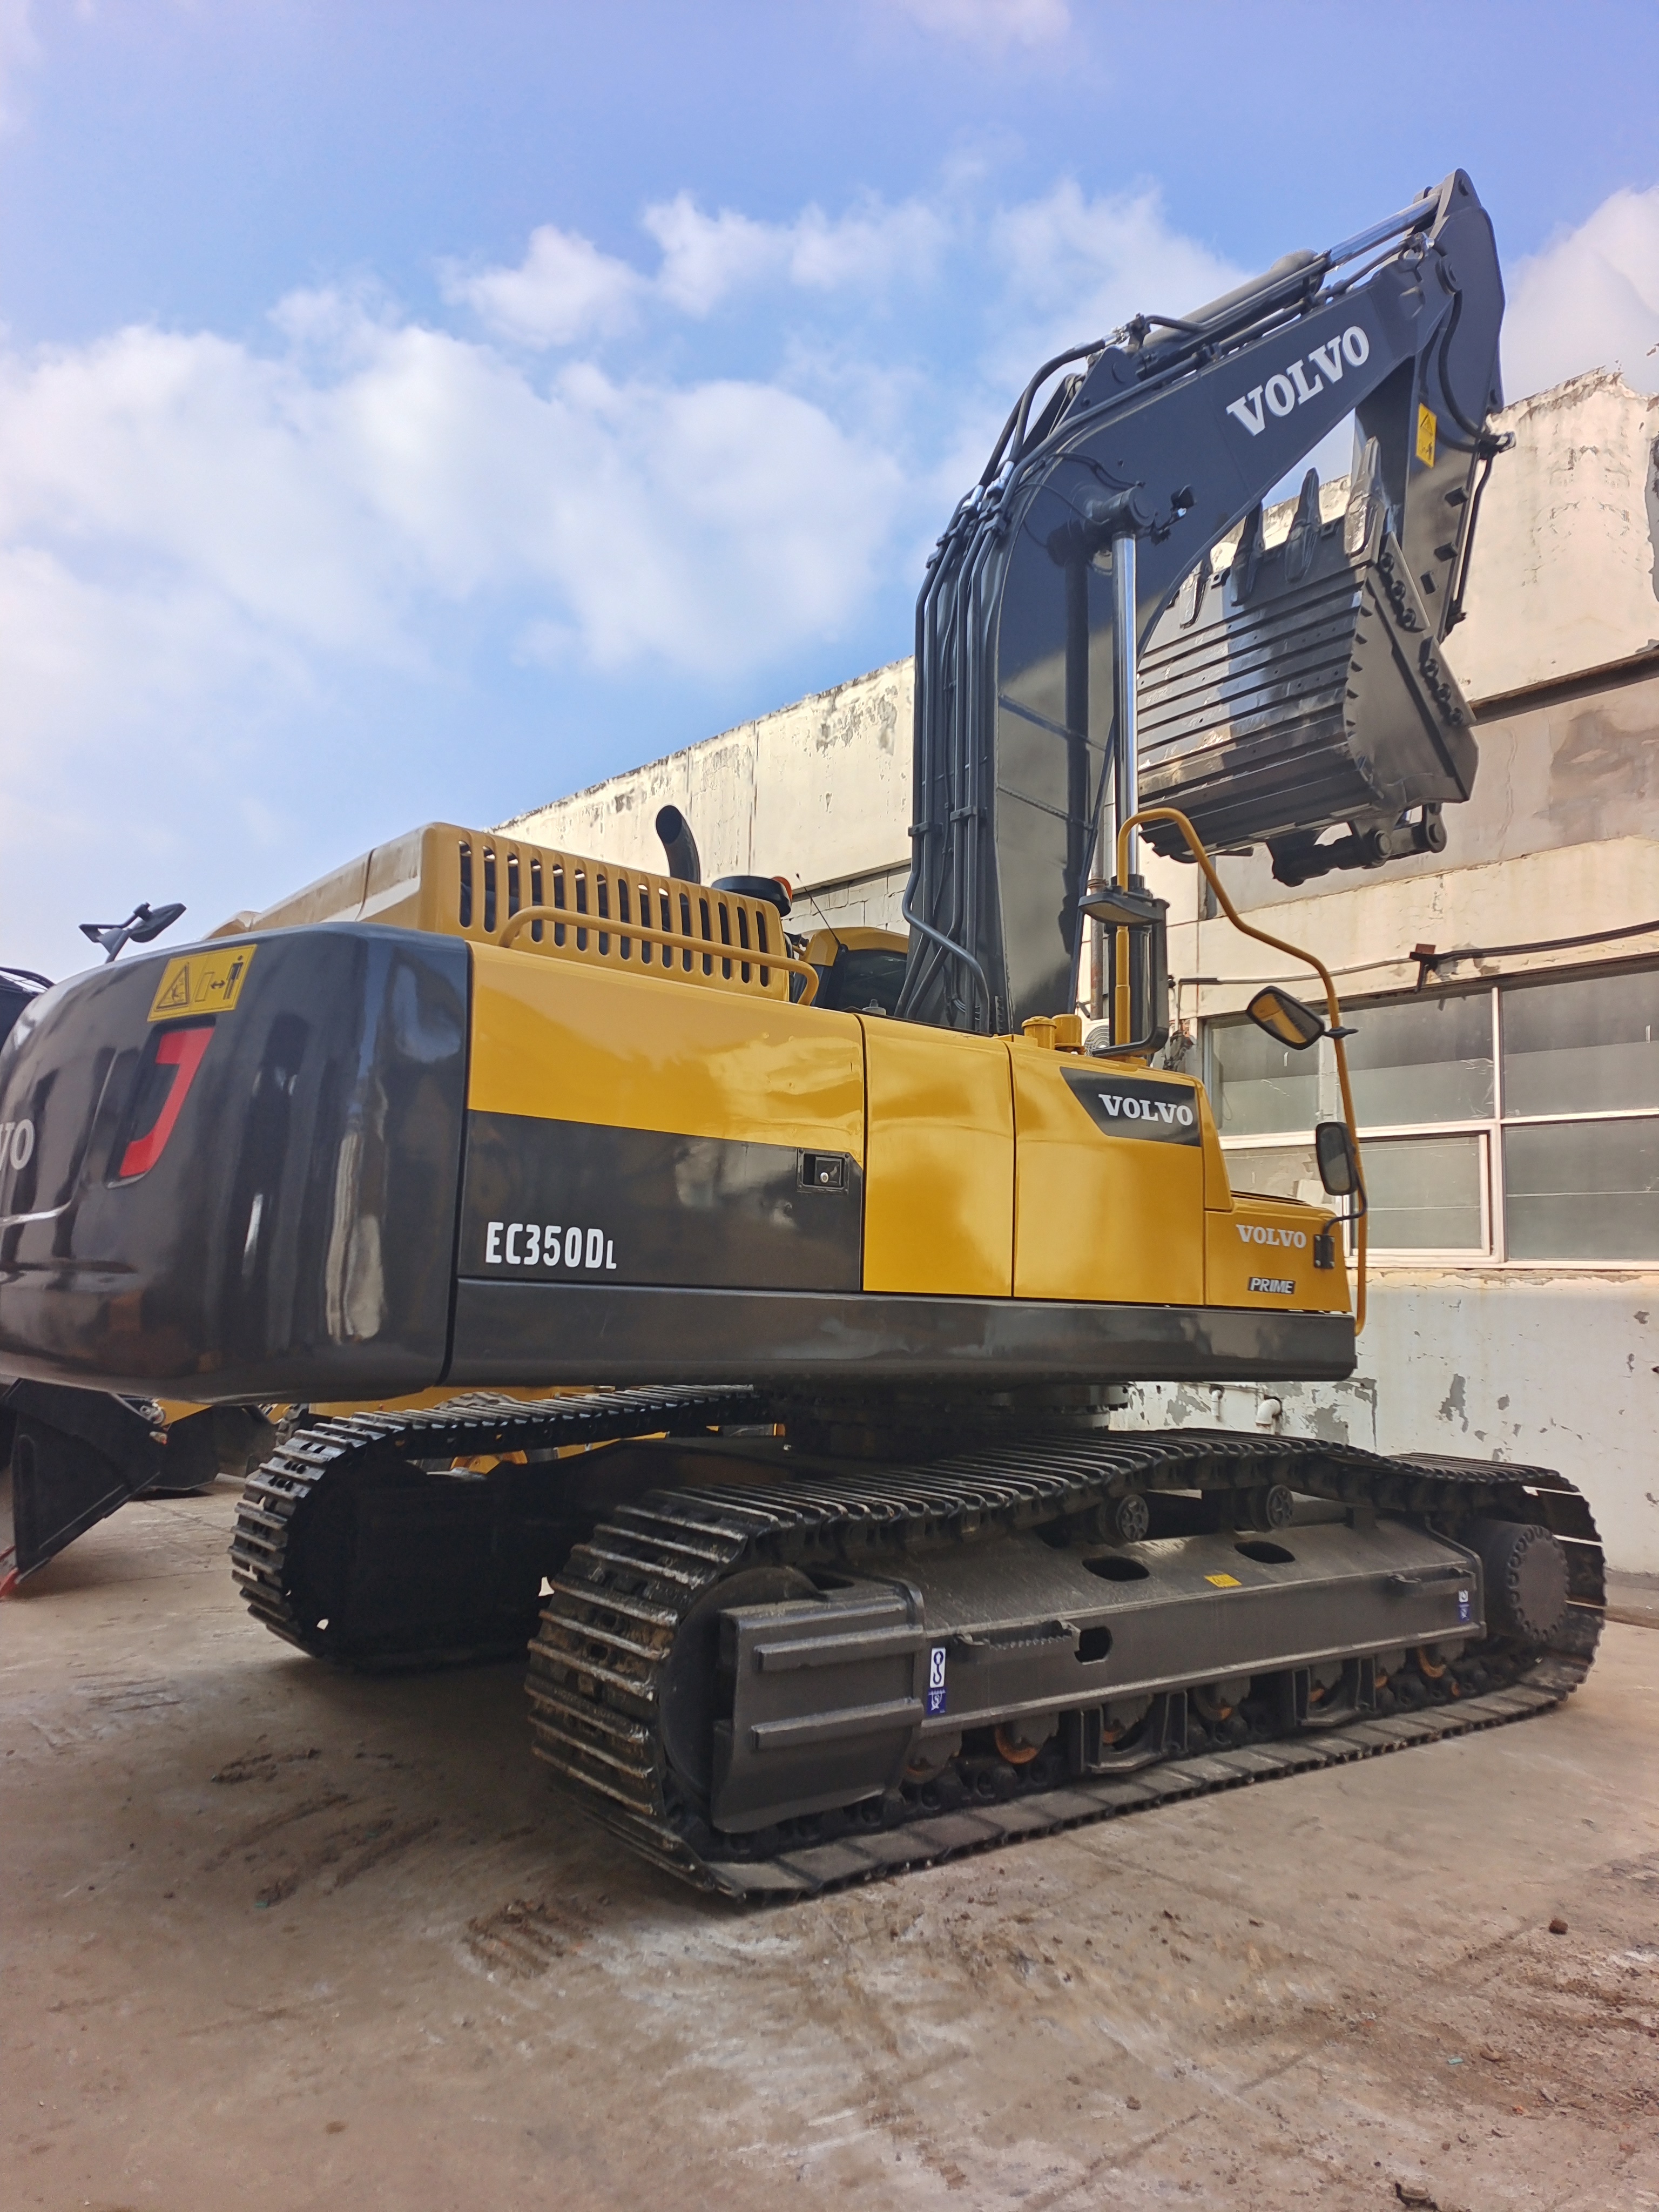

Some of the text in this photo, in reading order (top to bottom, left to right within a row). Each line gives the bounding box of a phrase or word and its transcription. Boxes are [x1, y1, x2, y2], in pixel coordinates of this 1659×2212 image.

[1226, 325, 1370, 436] VOLVO
[1098, 1094, 1193, 1126] VOLVO
[485, 1222, 617, 1269] EC350DL
[1235, 1224, 1307, 1249] VOLVO
[1250, 1277, 1294, 1294] PRIME
